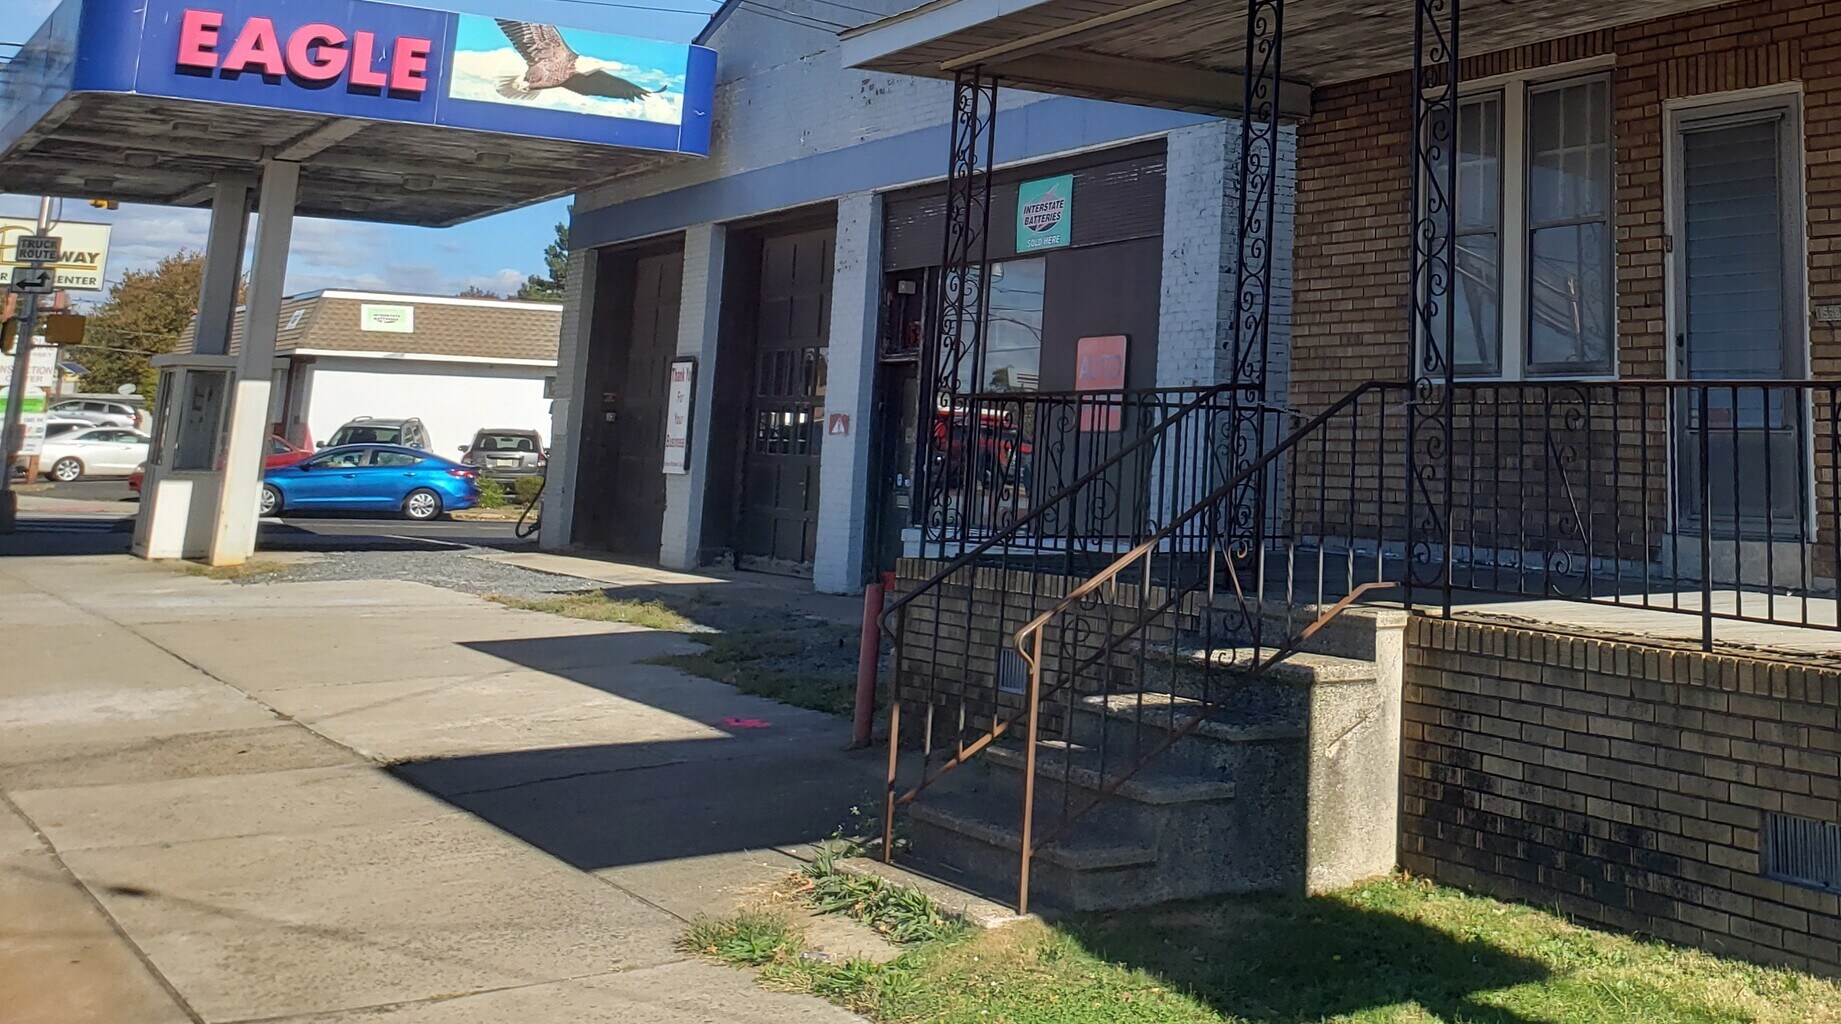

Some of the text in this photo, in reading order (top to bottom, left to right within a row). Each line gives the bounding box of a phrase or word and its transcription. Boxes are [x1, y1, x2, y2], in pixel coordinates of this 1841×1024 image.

[177, 8, 431, 92] EAGLE
[1023, 200, 1064, 214] INTERSTATE
[1024, 212, 1061, 225] BATTERIES
[21, 239, 57, 249] TRUCK
[1027, 235, 1060, 247] SOLD HERE
[20, 249, 57, 259] ROUTE
[60, 251, 100, 264] WAY
[57, 275, 97, 285] ENTER
